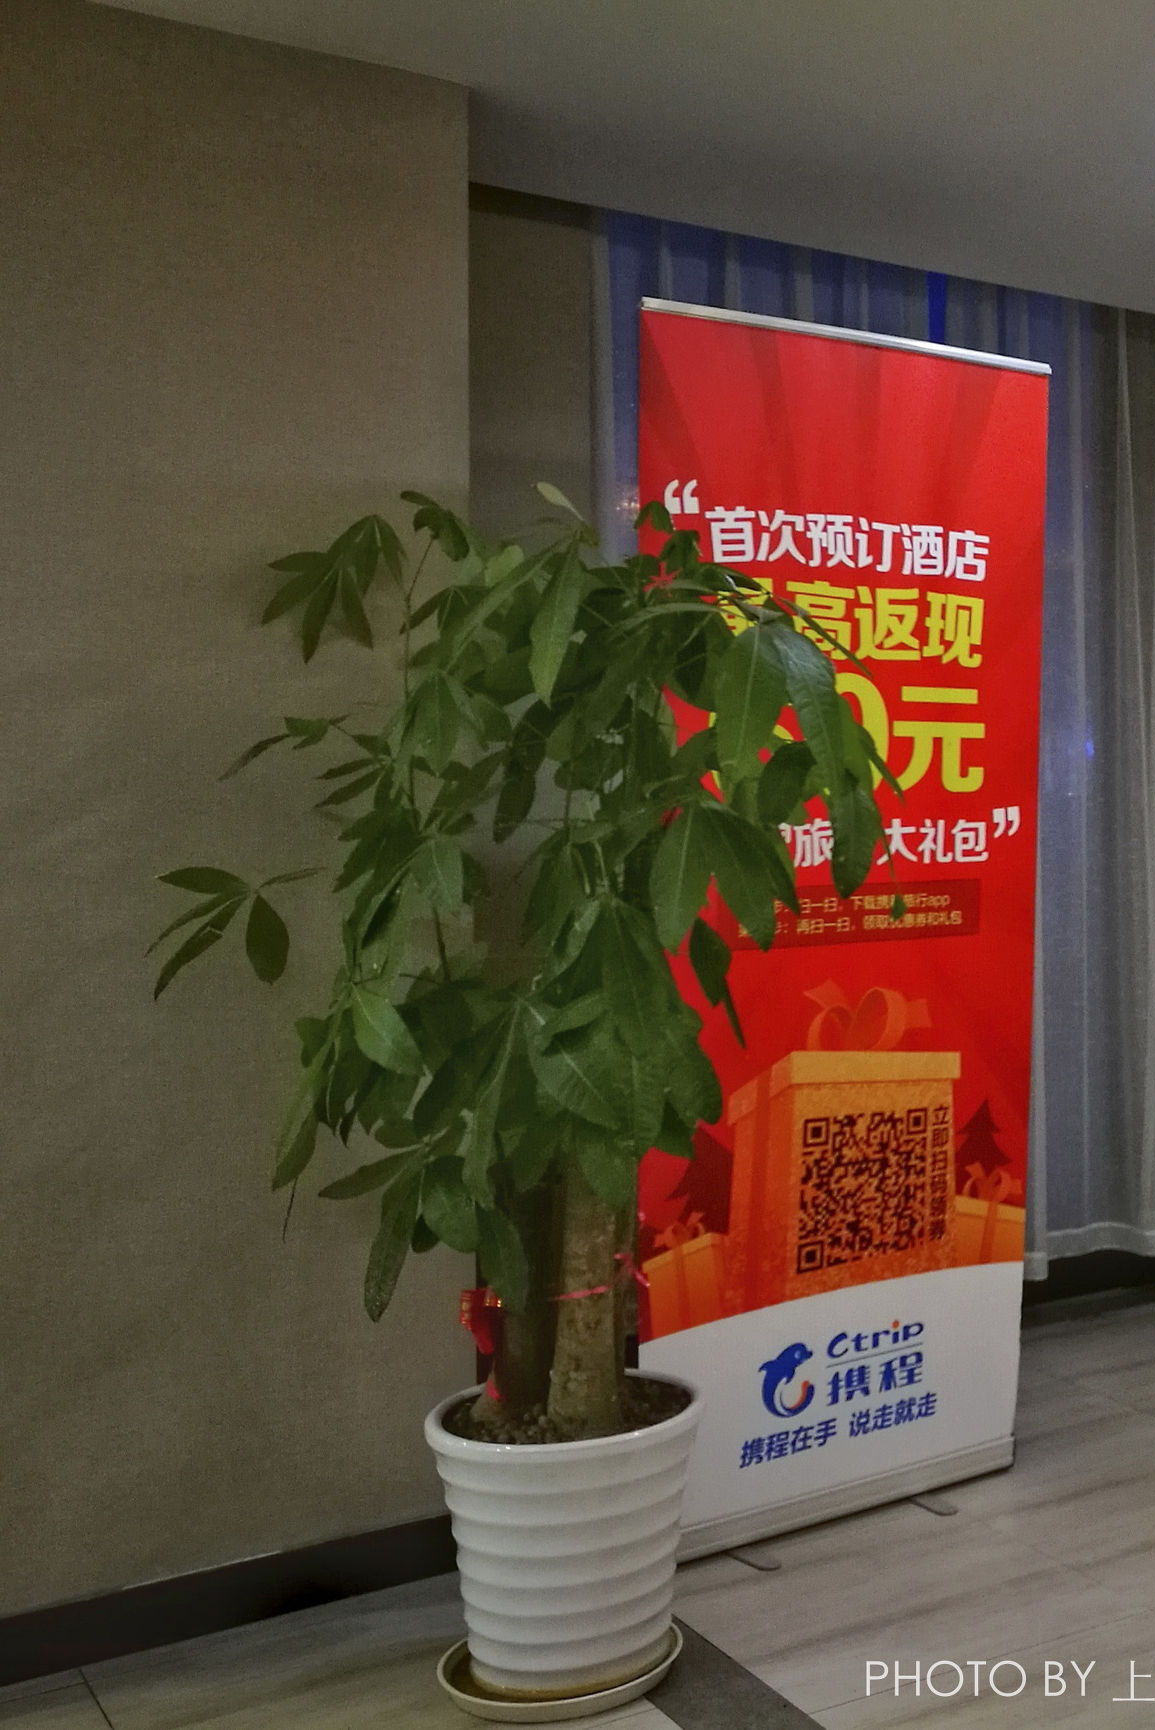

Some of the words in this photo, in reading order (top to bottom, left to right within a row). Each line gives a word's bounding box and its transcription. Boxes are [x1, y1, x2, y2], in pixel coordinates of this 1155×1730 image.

[826, 1319, 925, 1359] Ctrip
[826, 1351, 924, 1407] 携程
[739, 1418, 837, 1469] 携程在手
[849, 1392, 937, 1437] 说走就走
